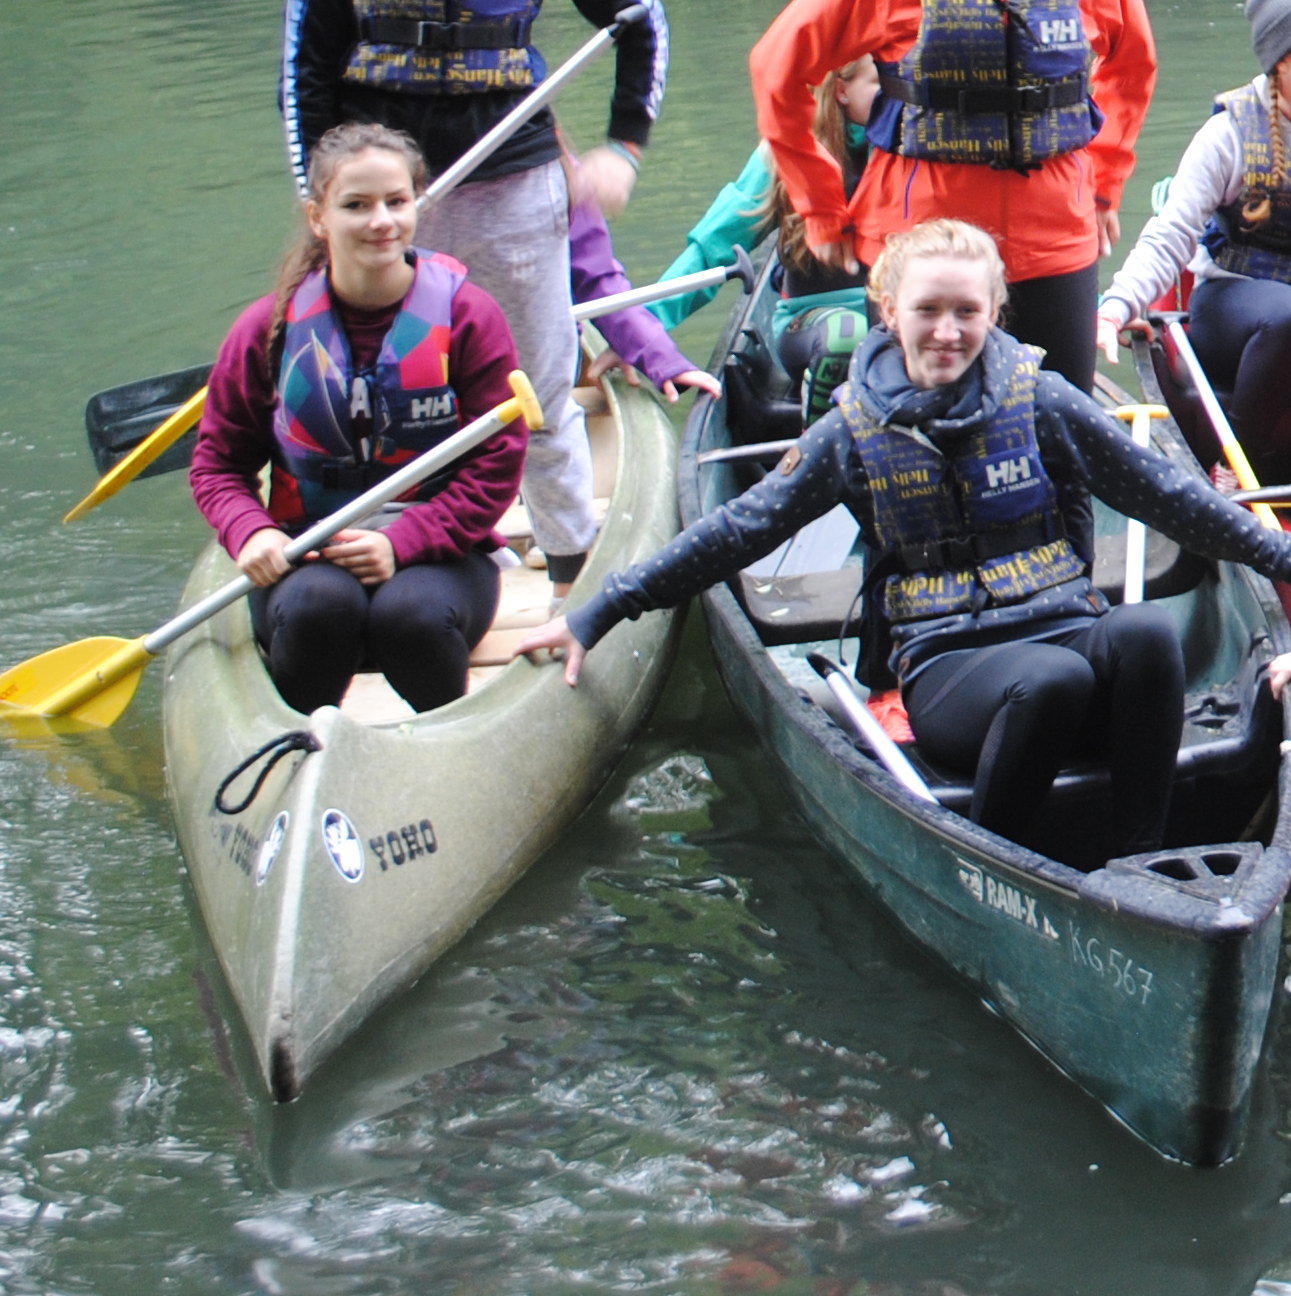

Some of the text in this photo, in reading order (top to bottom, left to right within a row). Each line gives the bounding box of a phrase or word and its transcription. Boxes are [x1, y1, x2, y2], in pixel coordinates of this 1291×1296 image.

[1040, 18, 1078, 43] HH
[412, 394, 452, 419] HH
[985, 456, 1031, 488] HH
[369, 818, 438, 871] YOHO
[986, 875, 1039, 930] RAM-X
